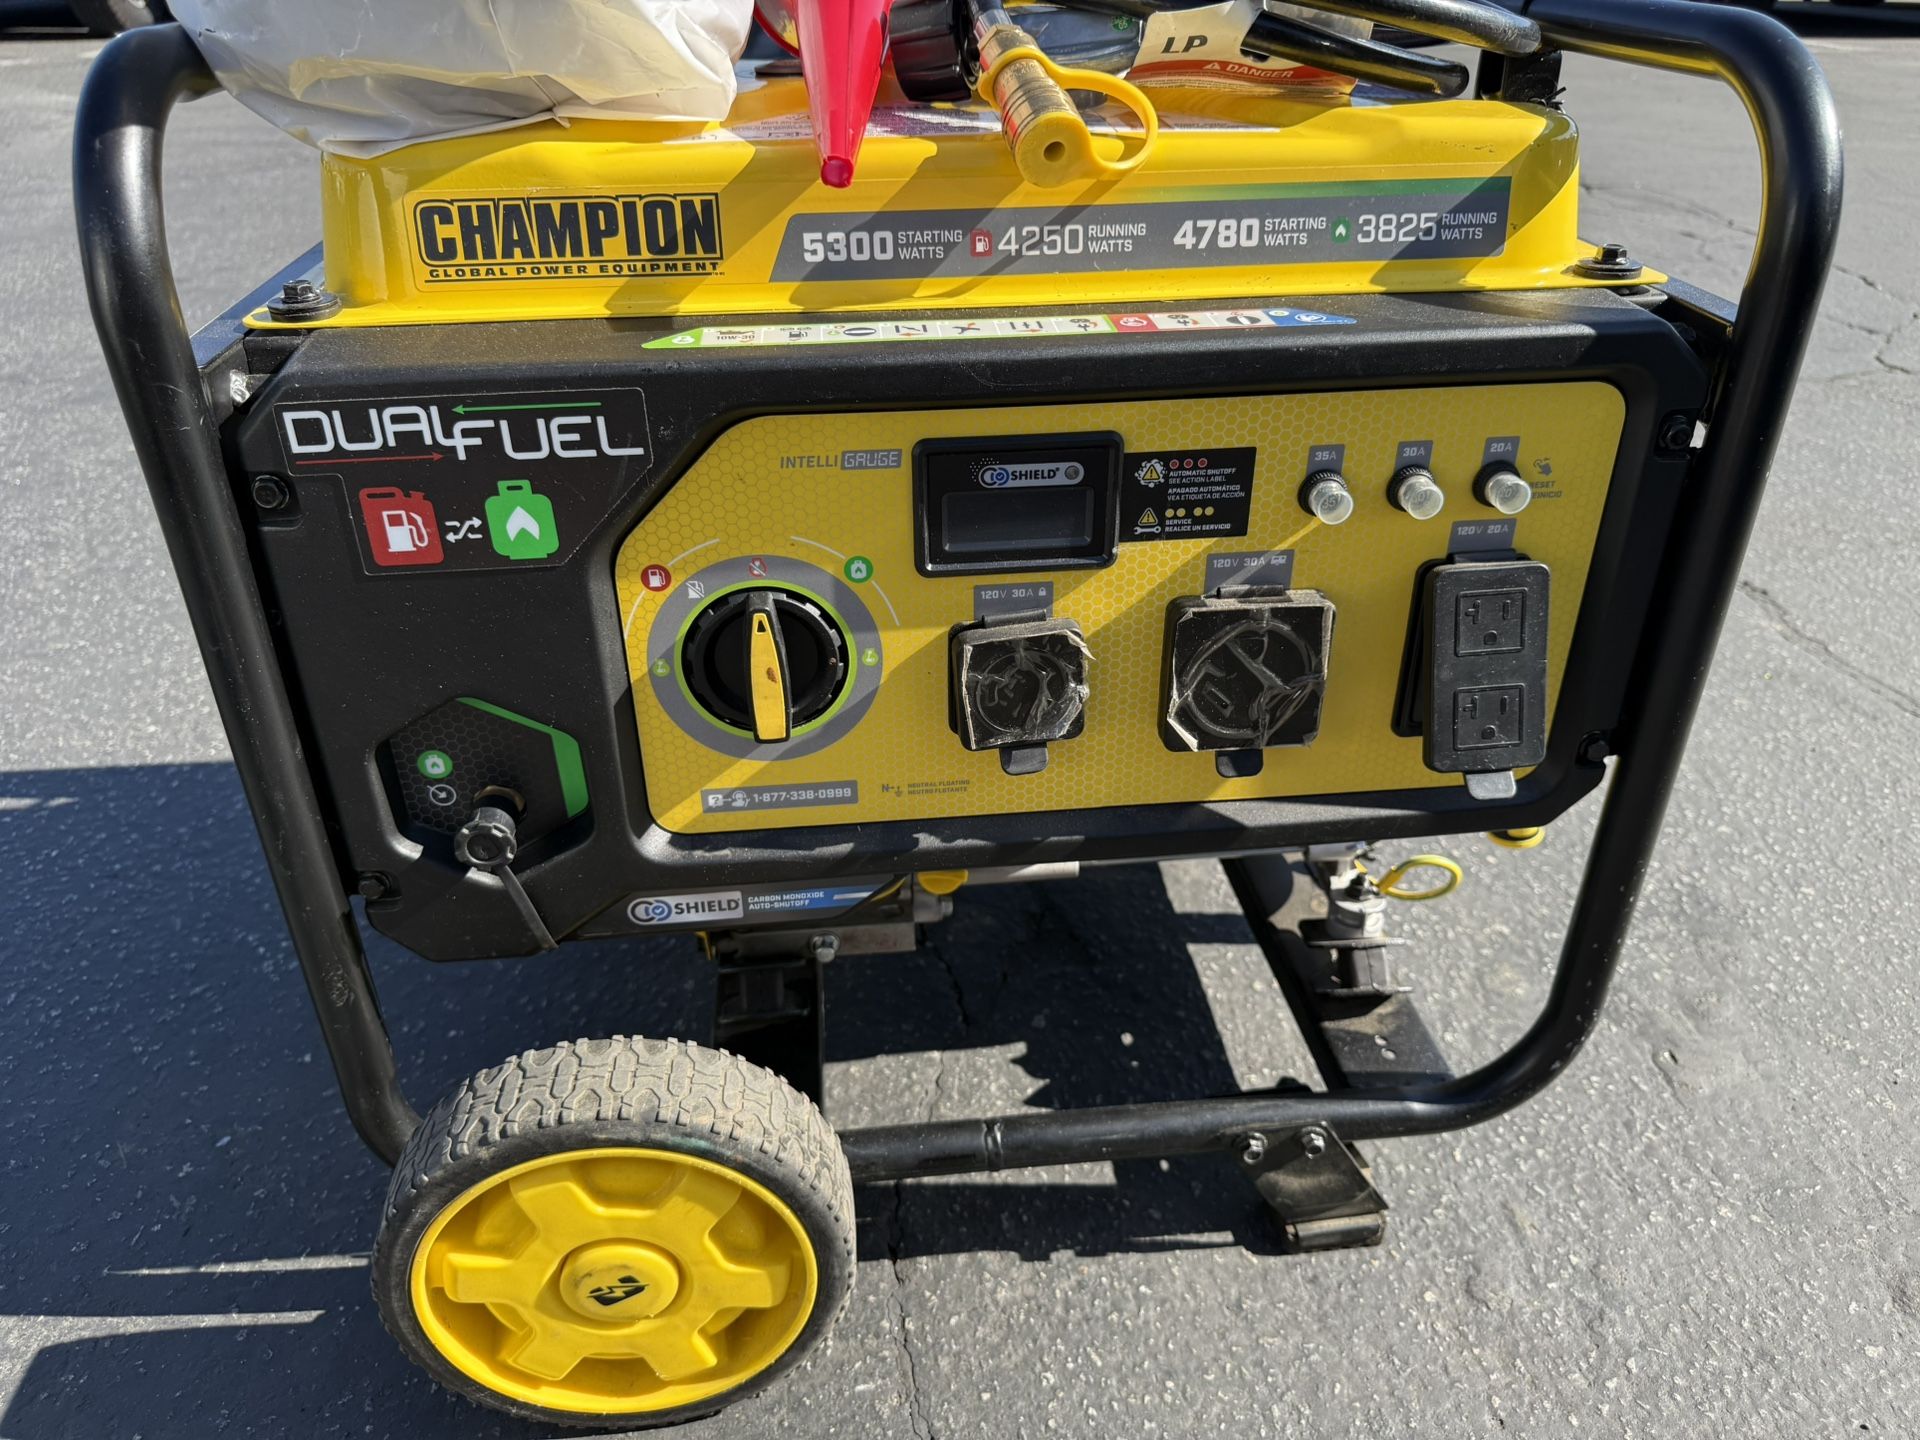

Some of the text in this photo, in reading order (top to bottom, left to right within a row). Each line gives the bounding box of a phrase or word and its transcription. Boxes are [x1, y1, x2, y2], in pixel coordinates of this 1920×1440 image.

[1161, 35, 1209, 54] LP
[1226, 62, 1295, 79] DANGER
[1264, 217, 1327, 231] STARTING
[1441, 212, 1498, 225] RUNNING
[419, 199, 717, 262] CHAMPION
[1088, 224, 1146, 238] RUNNING
[1173, 218, 1260, 249] 4780
[1357, 213, 1438, 243] 3825
[1440, 227, 1483, 241] WATTS
[898, 230, 963, 244] STARTING
[998, 225, 1084, 256] 4250
[1264, 233, 1308, 247] WATTS
[802, 231, 894, 262] 5300
[898, 246, 944, 260] WATTS
[1088, 239, 1133, 253] WATTS
[429, 267, 508, 279] GLOBAL
[516, 265, 589, 276] POWER
[599, 261, 720, 275] EQUIPMENT
[282, 405, 645, 461] DUAL FUEL
[1402, 447, 1425, 457] 30A
[1489, 442, 1513, 453] 20A
[780, 451, 899, 469] INTELLI GAUGE
[1314, 450, 1337, 461] 35A
[1168, 467, 1237, 477] AUTOMATIC SHUTOFF
[1182, 476, 1206, 484] ACTION
[1167, 484, 1241, 494] APAGADO AUTOMÁTICO
[1180, 493, 1212, 501] ETIQUETA
[1221, 490, 1245, 499] ACCIÓN
[1164, 525, 1192, 533] REALICE
[1201, 523, 1231, 531] SERVICIO
[1165, 518, 1192, 526] SERVICE
[1457, 524, 1509, 536] 120V 20A
[1212, 556, 1265, 568] 120V 30A
[980, 588, 1034, 600] 120V 30A
[938, 779, 970, 787] FLOATING
[748, 891, 825, 903] CARBON MONOXIDE
[748, 899, 810, 911] AUTO-SHUTOFF
